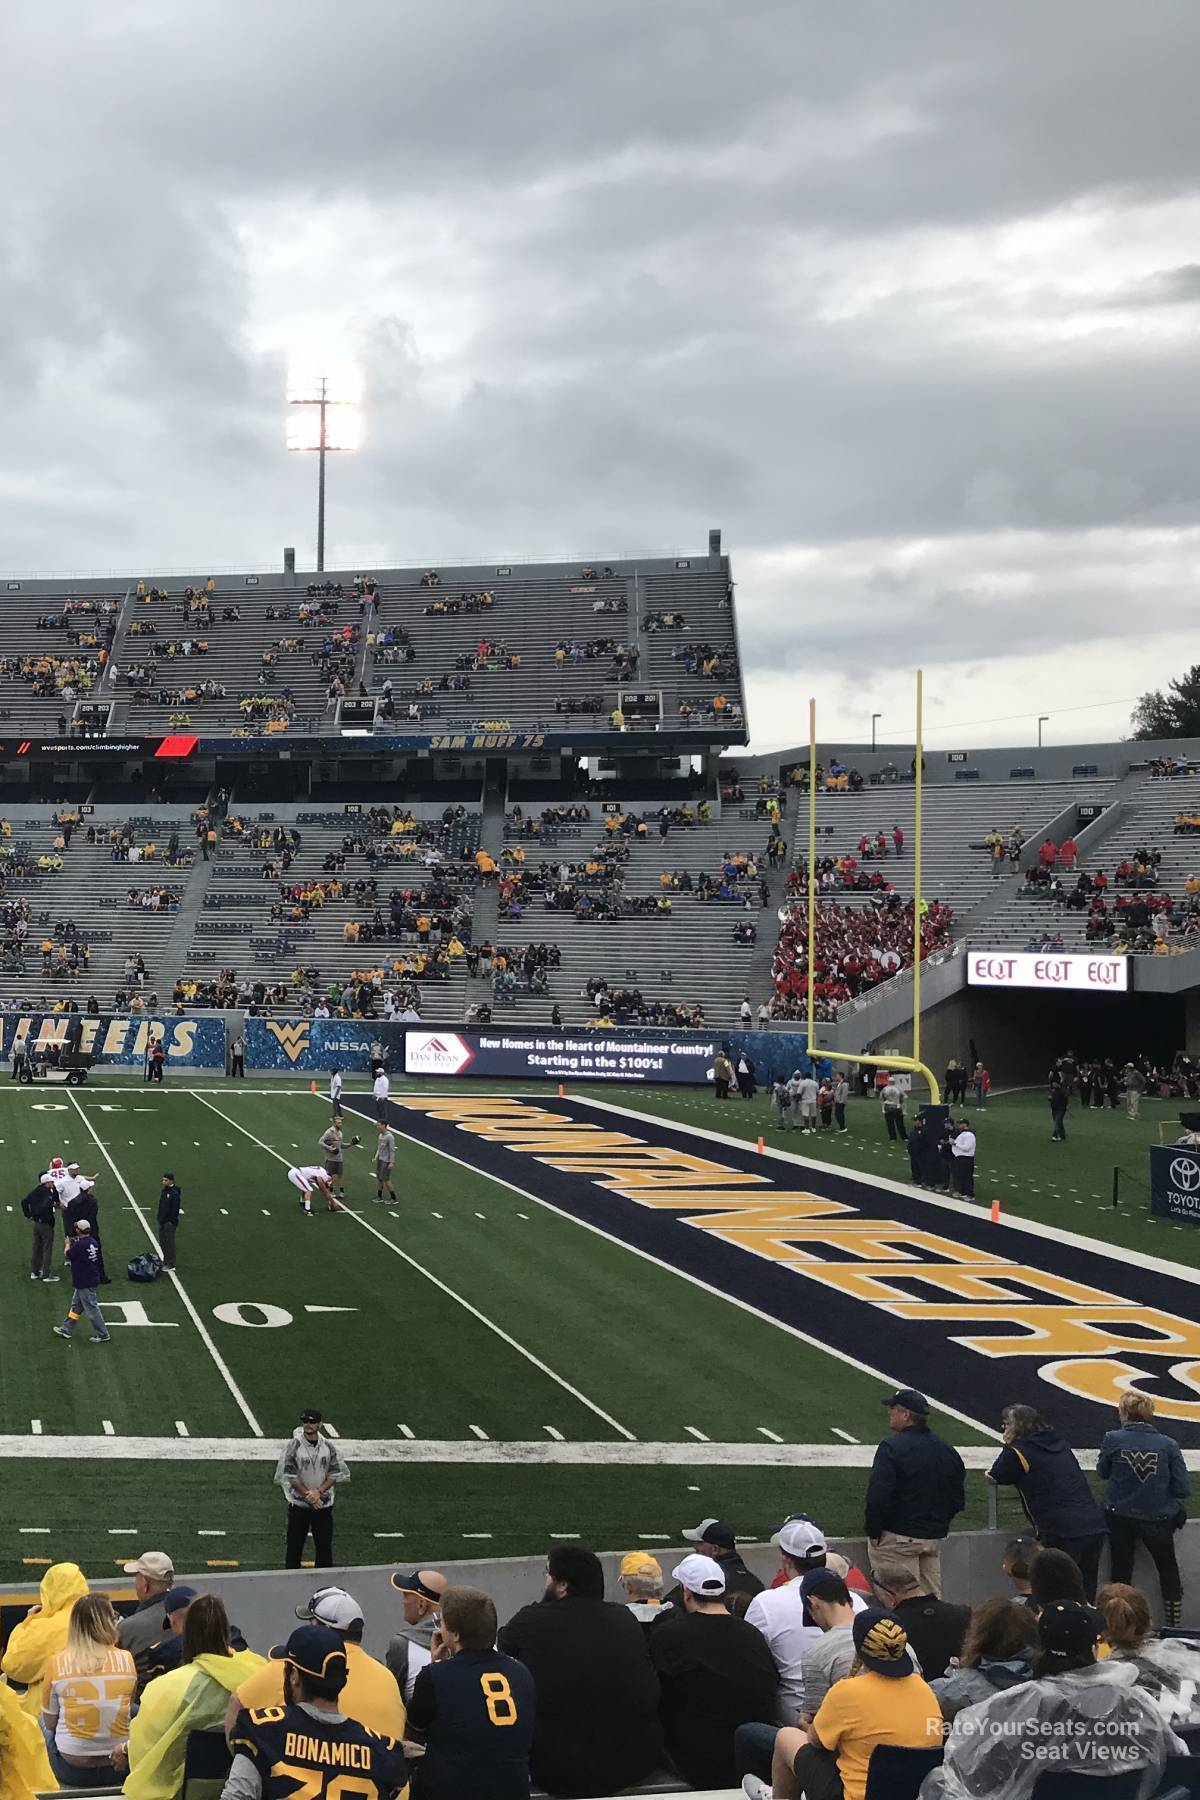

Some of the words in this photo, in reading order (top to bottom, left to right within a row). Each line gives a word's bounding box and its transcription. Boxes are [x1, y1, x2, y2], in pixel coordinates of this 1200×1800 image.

[430, 735, 467, 749] SAM
[472, 735, 516, 749] HUFF
[522, 734, 545, 748] 75
[975, 959, 1017, 980] EQT
[1034, 960, 1072, 982] EQT
[1088, 962, 1121, 984] EQT
[324, 1041, 379, 1051] NISSA
[479, 1037, 500, 1049] New
[502, 1038, 534, 1050] Homes
[536, 1039, 546, 1050] in
[547, 1039, 564, 1051] the
[566, 1040, 593, 1052] Heart
[594, 1041, 606, 1053] of
[606, 1041, 669, 1055] Mountaineer
[670, 1043, 713, 1058] Country!
[410, 1051, 430, 1062] DAN
[434, 1052, 459, 1063] RYAN
[527, 1054, 578, 1068] Starting
[580, 1055, 593, 1067] in
[594, 1056, 616, 1068] the
[619, 1057, 663, 1069] $100's!
[1167, 1191, 1200, 1209] TOYOT
[480, 1672, 518, 1726] 8
[285, 1732, 372, 1770] BONAMICO
